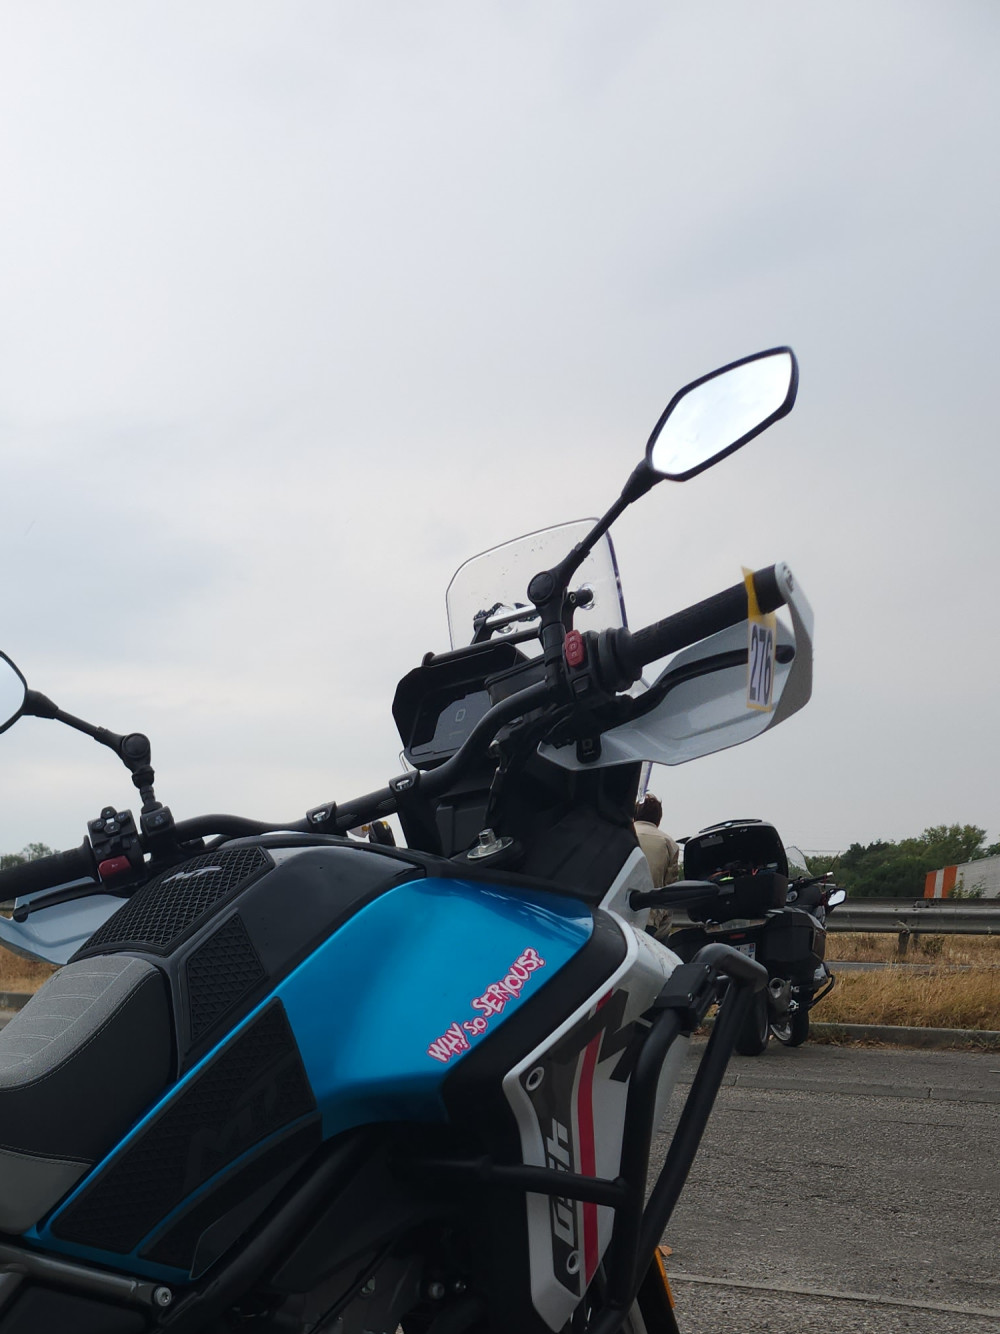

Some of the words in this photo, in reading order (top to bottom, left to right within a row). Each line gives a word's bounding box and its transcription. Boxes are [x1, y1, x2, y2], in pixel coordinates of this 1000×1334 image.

[749, 624, 773, 706] 276
[427, 1022, 470, 1062] WHY
[471, 946, 546, 1017] SERIOUS?
